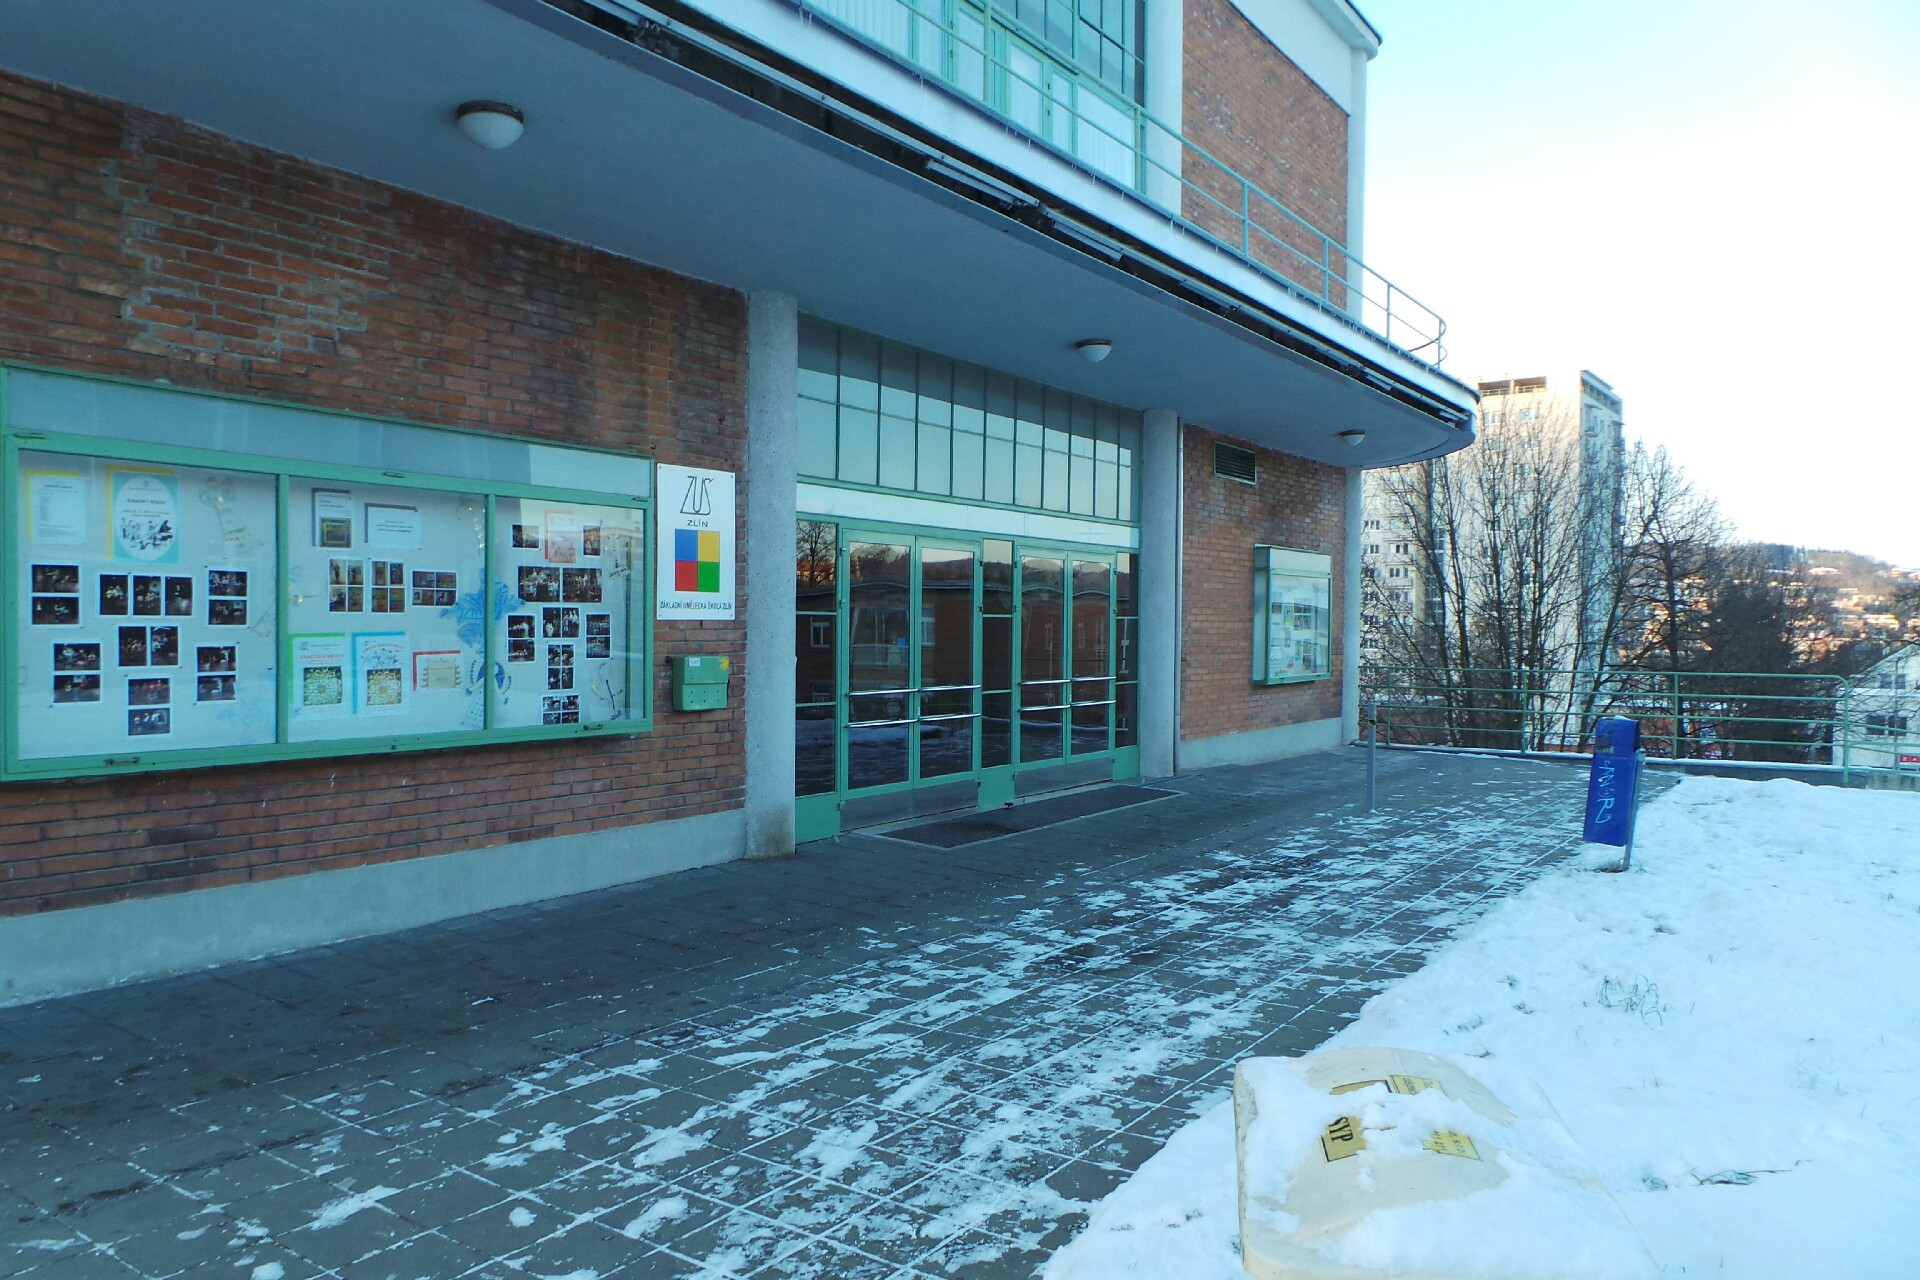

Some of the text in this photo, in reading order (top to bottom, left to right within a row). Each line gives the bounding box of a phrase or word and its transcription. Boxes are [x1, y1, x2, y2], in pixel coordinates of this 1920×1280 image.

[687, 519, 709, 528] ZLÍN
[660, 600, 682, 609] ZÁKLADNÍ
[708, 600, 722, 610] ŠKOLA
[722, 601, 732, 610] ZLÍN
